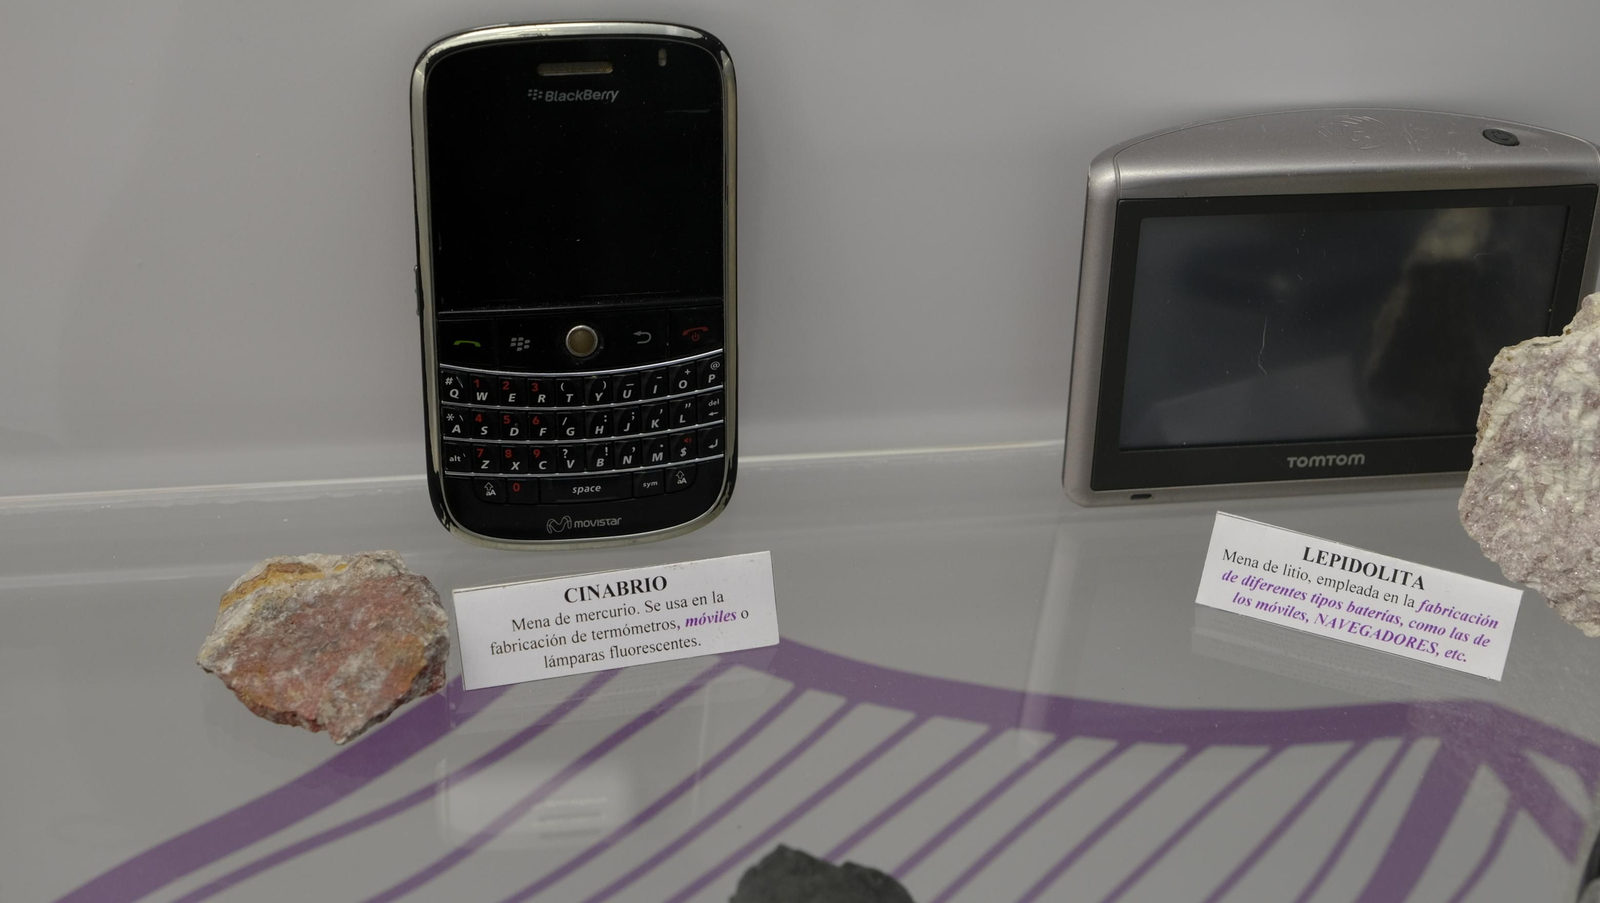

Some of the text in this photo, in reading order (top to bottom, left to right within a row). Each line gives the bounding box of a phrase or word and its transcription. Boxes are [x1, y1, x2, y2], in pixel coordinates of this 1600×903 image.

[545, 89, 619, 103] BlackBerry
[450, 389, 459, 398] Q
[477, 392, 488, 400] W
[509, 394, 516, 402] E
[567, 394, 573, 402] T
[595, 393, 603, 401] Y
[623, 390, 631, 398] U
[653, 385, 657, 393] I
[679, 380, 687, 388] O
[708, 374, 715, 383] P
[452, 415, 685, 436] A S D F G H J K L
[477, 448, 484, 457] 7
[505, 449, 512, 458] 8
[533, 449, 540, 458] 9
[563, 449, 568, 458] ?
[481, 460, 489, 468] Z
[511, 462, 520, 470] X
[539, 461, 547, 469] C
[567, 460, 575, 468] V
[597, 458, 604, 467] B
[623, 455, 632, 464] N
[652, 452, 663, 461] M
[680, 447, 686, 457] $
[1287, 454, 1365, 468] TOMTOM
[486, 488, 496, 496] aA
[513, 483, 520, 492] 0
[573, 486, 601, 495] space
[676, 475, 687, 484] aA
[574, 518, 622, 528] movistar
[1303, 546, 1425, 591] LEPIDOLITA
[564, 576, 667, 603] CINABRIO
[1222, 549, 1499, 629] Mena de litio, empleada en la fabricación
[512, 591, 724, 632] Mena de mercurio. Se usa en la
[1222, 570, 1490, 648] de diferentes tipos baterías, como las de
[490, 610, 749, 655] fabricación de termómetros, móviles o
[1232, 593, 1467, 662] los móviles, NAVEGADORES, etc.
[544, 636, 701, 669] lámparas fluorescentes.
